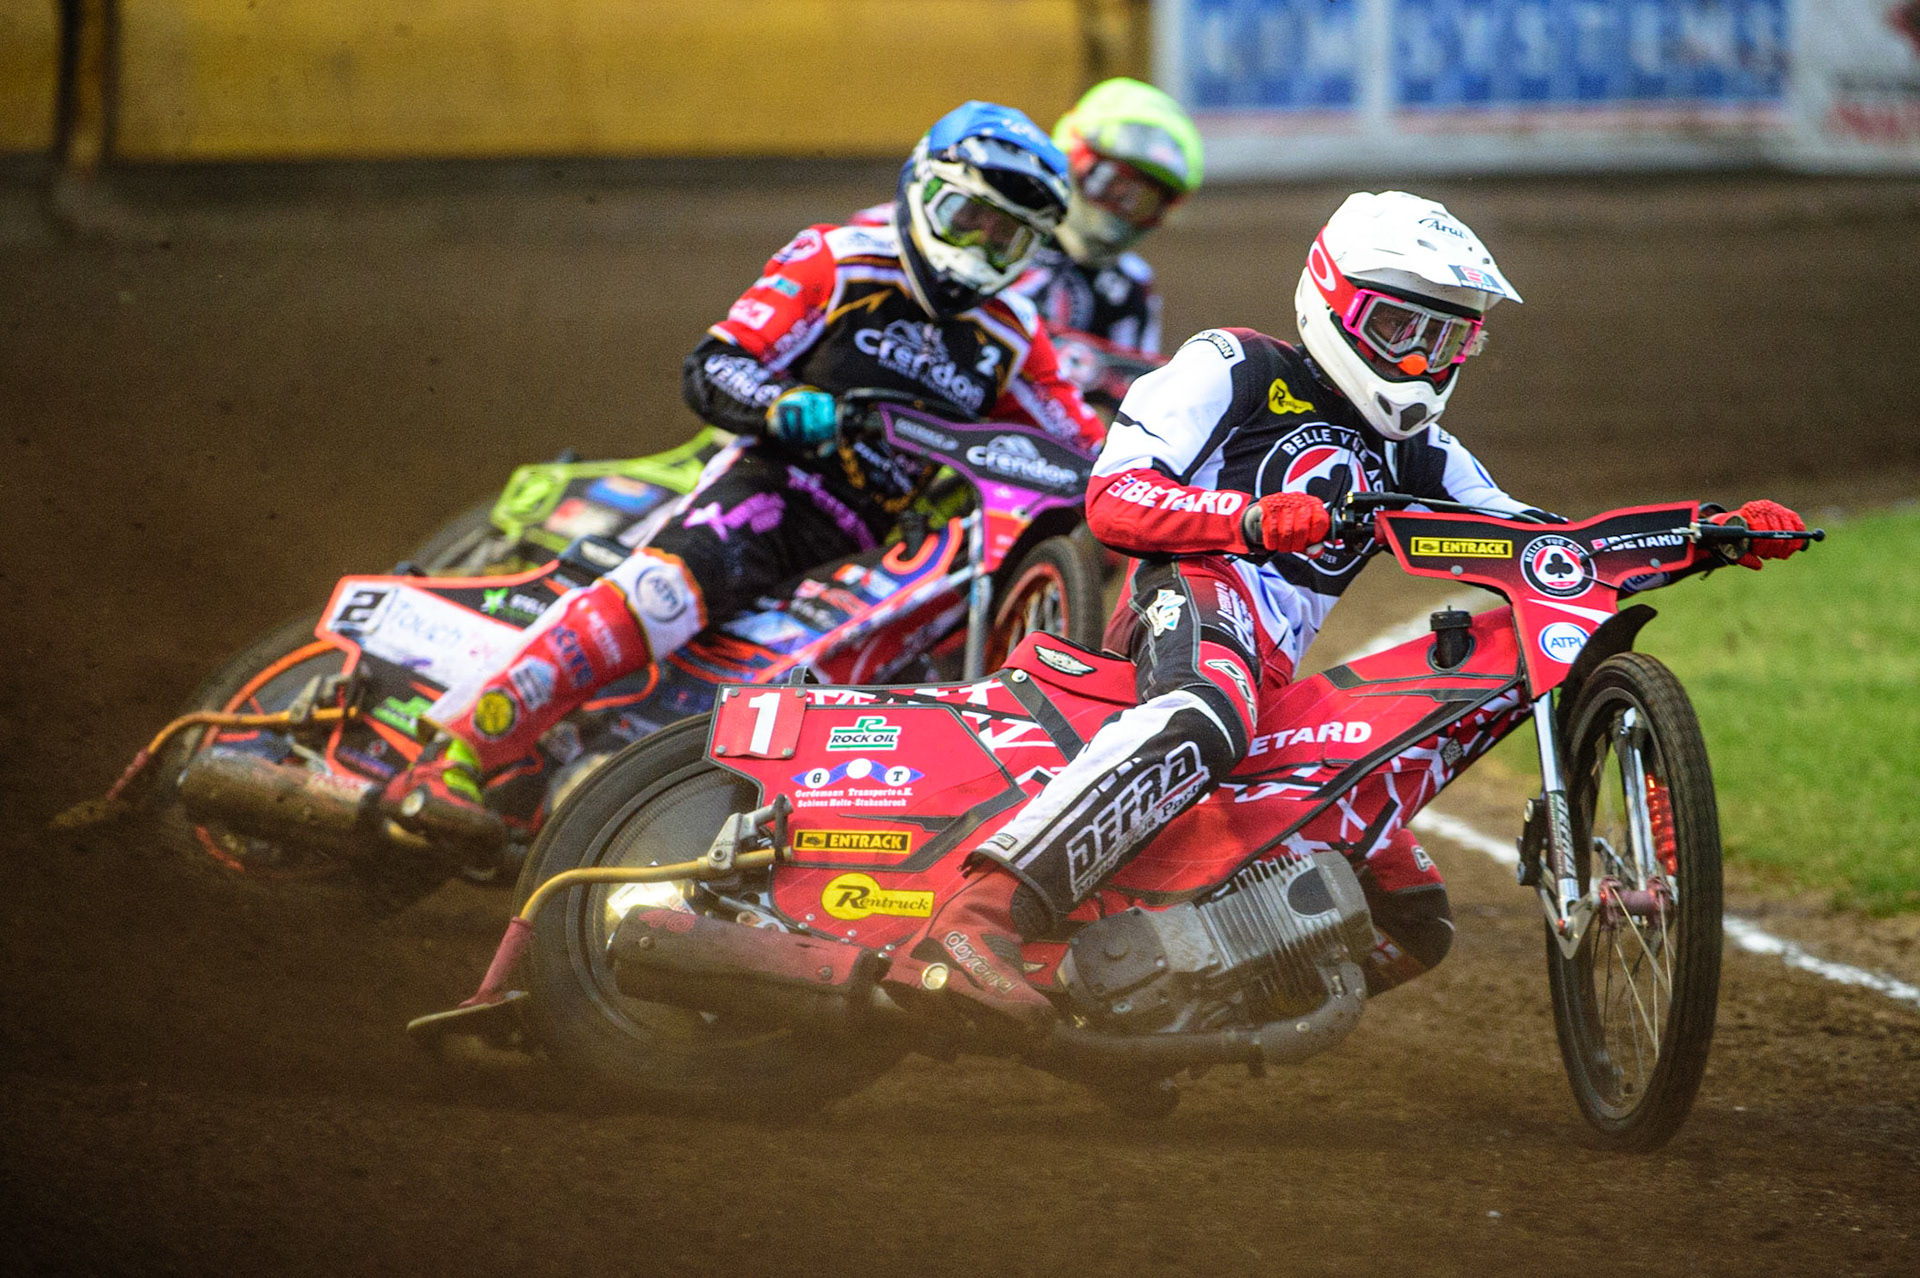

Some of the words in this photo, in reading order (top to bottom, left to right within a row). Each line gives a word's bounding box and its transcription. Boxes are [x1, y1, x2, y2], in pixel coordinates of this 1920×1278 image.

[976, 345, 1000, 376] 2
[1282, 429, 1332, 456] BELLE
[1340, 432, 1368, 462] VUE
[1121, 480, 1242, 515] BETARD
[1442, 541, 1505, 554] ENTRACK
[338, 591, 389, 621] 2
[748, 692, 781, 755] 1
[831, 734, 871, 743] ROCK
[873, 734, 895, 743] OIL
[1248, 721, 1372, 757] ETARD
[829, 835, 902, 849] ENTRACK
[835, 884, 929, 910] Rentruck
